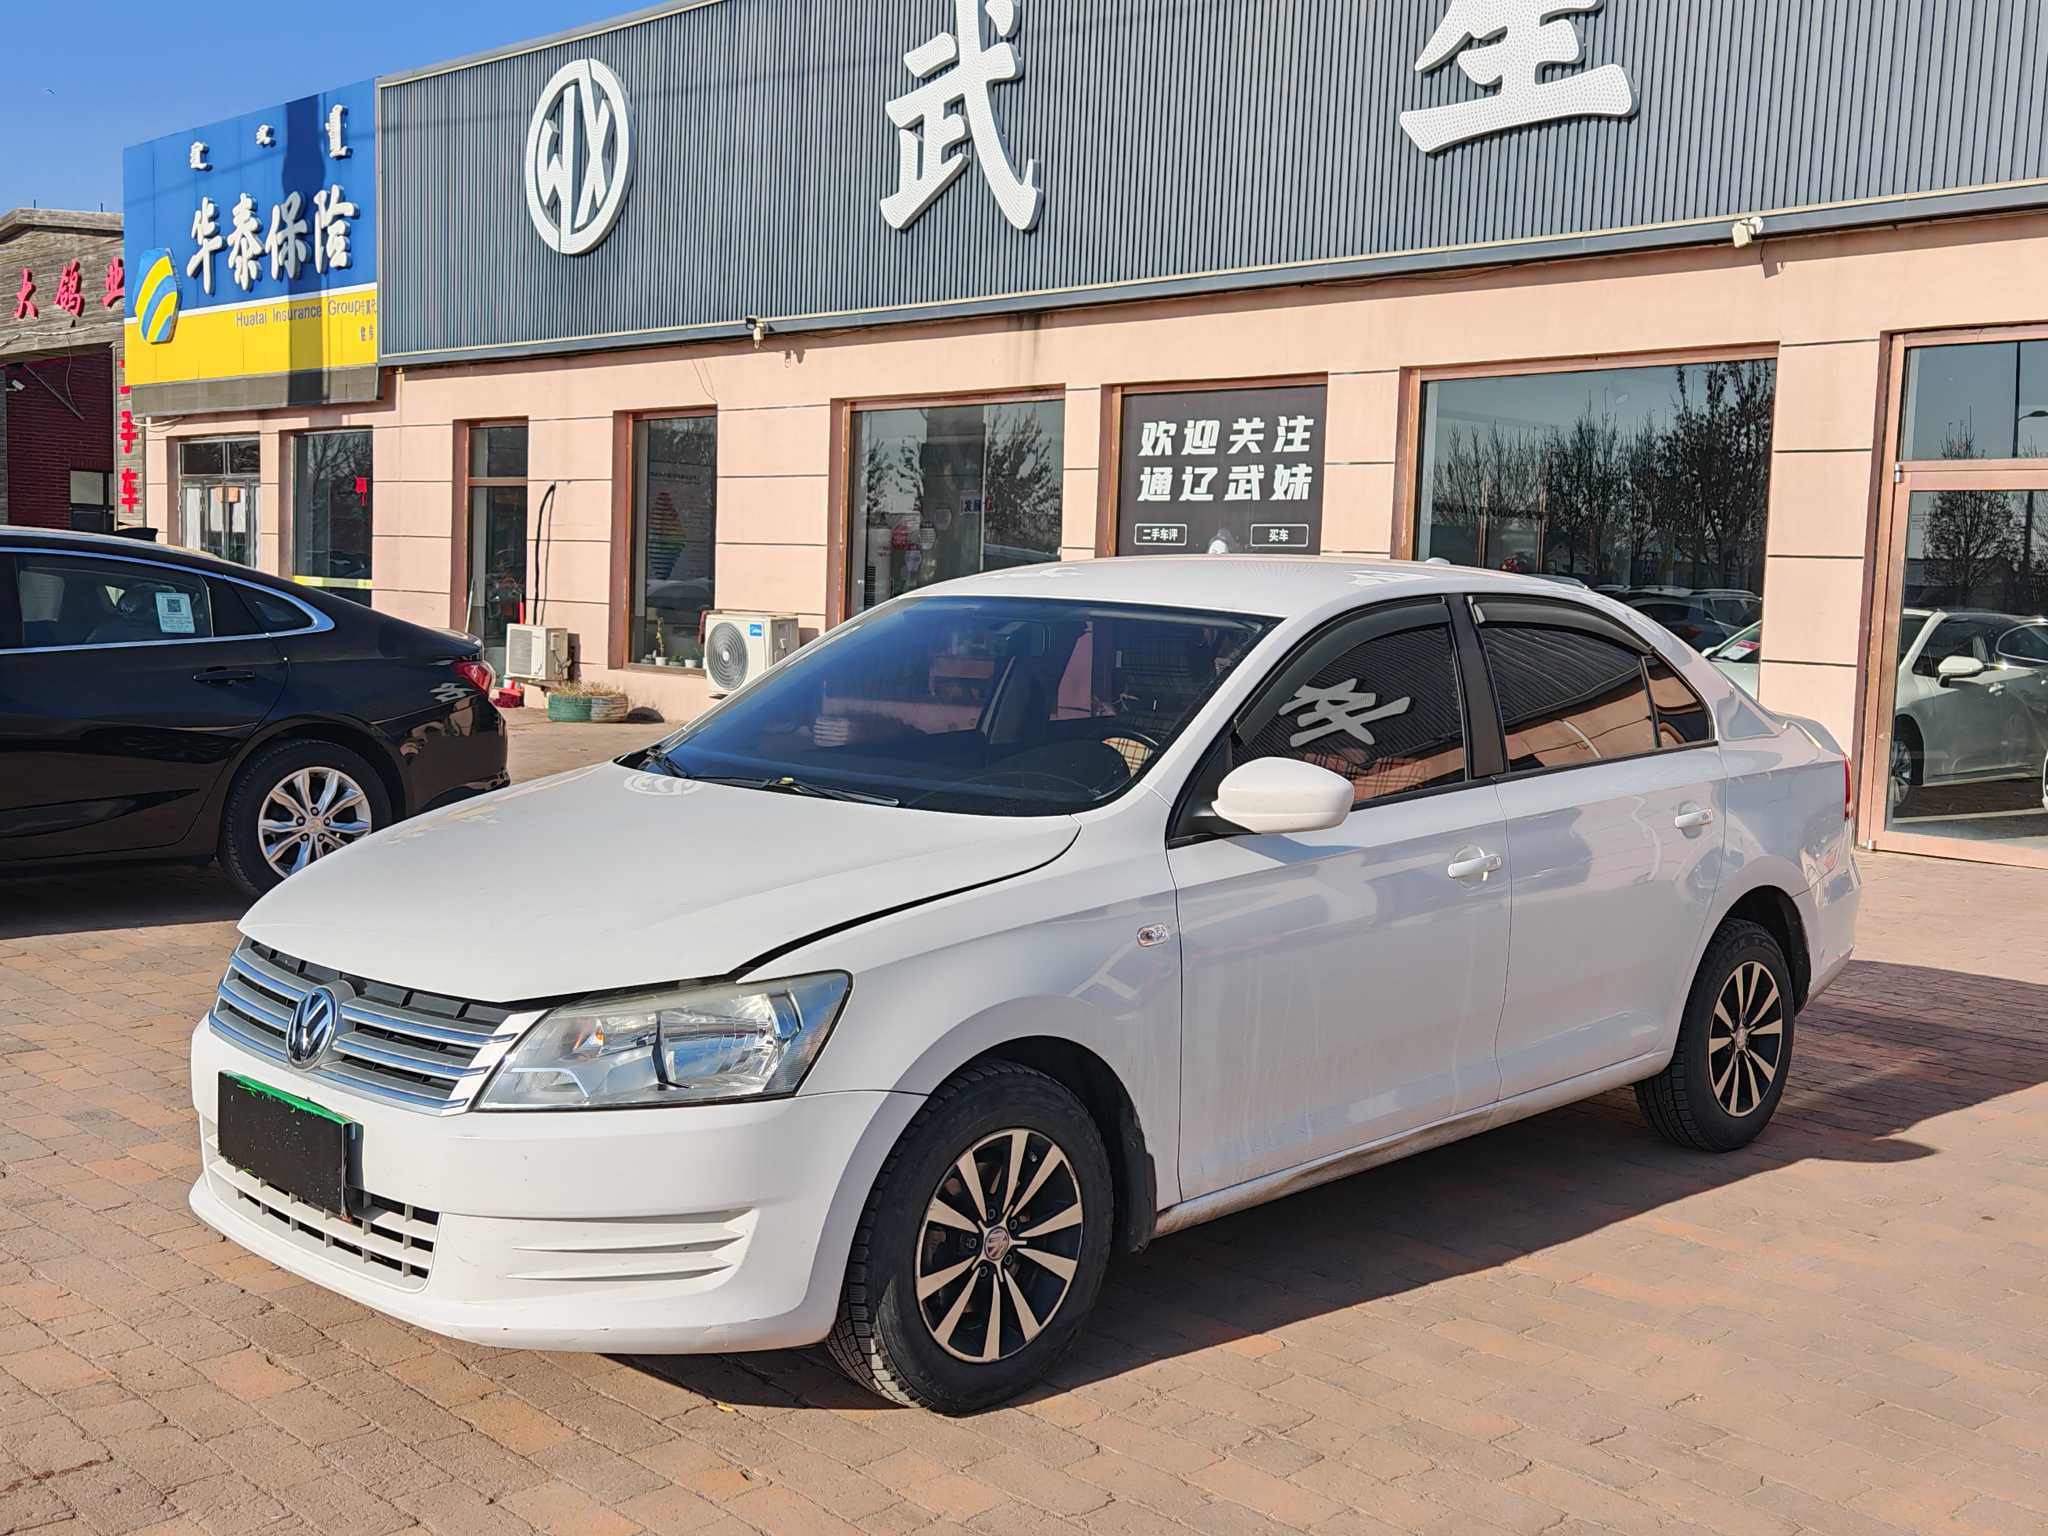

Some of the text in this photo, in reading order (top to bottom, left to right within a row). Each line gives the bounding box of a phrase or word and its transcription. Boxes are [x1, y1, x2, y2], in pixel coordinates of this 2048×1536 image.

[186, 184, 357, 295] 华泰保险
[236, 311, 267, 327] Huatai
[273, 304, 322, 322] Insurance
[328, 298, 360, 316] Group
[1138, 415, 1315, 456] 欢迎关注
[1136, 463, 1313, 501] 通辽武妹
[1268, 528, 1289, 542] 买车
